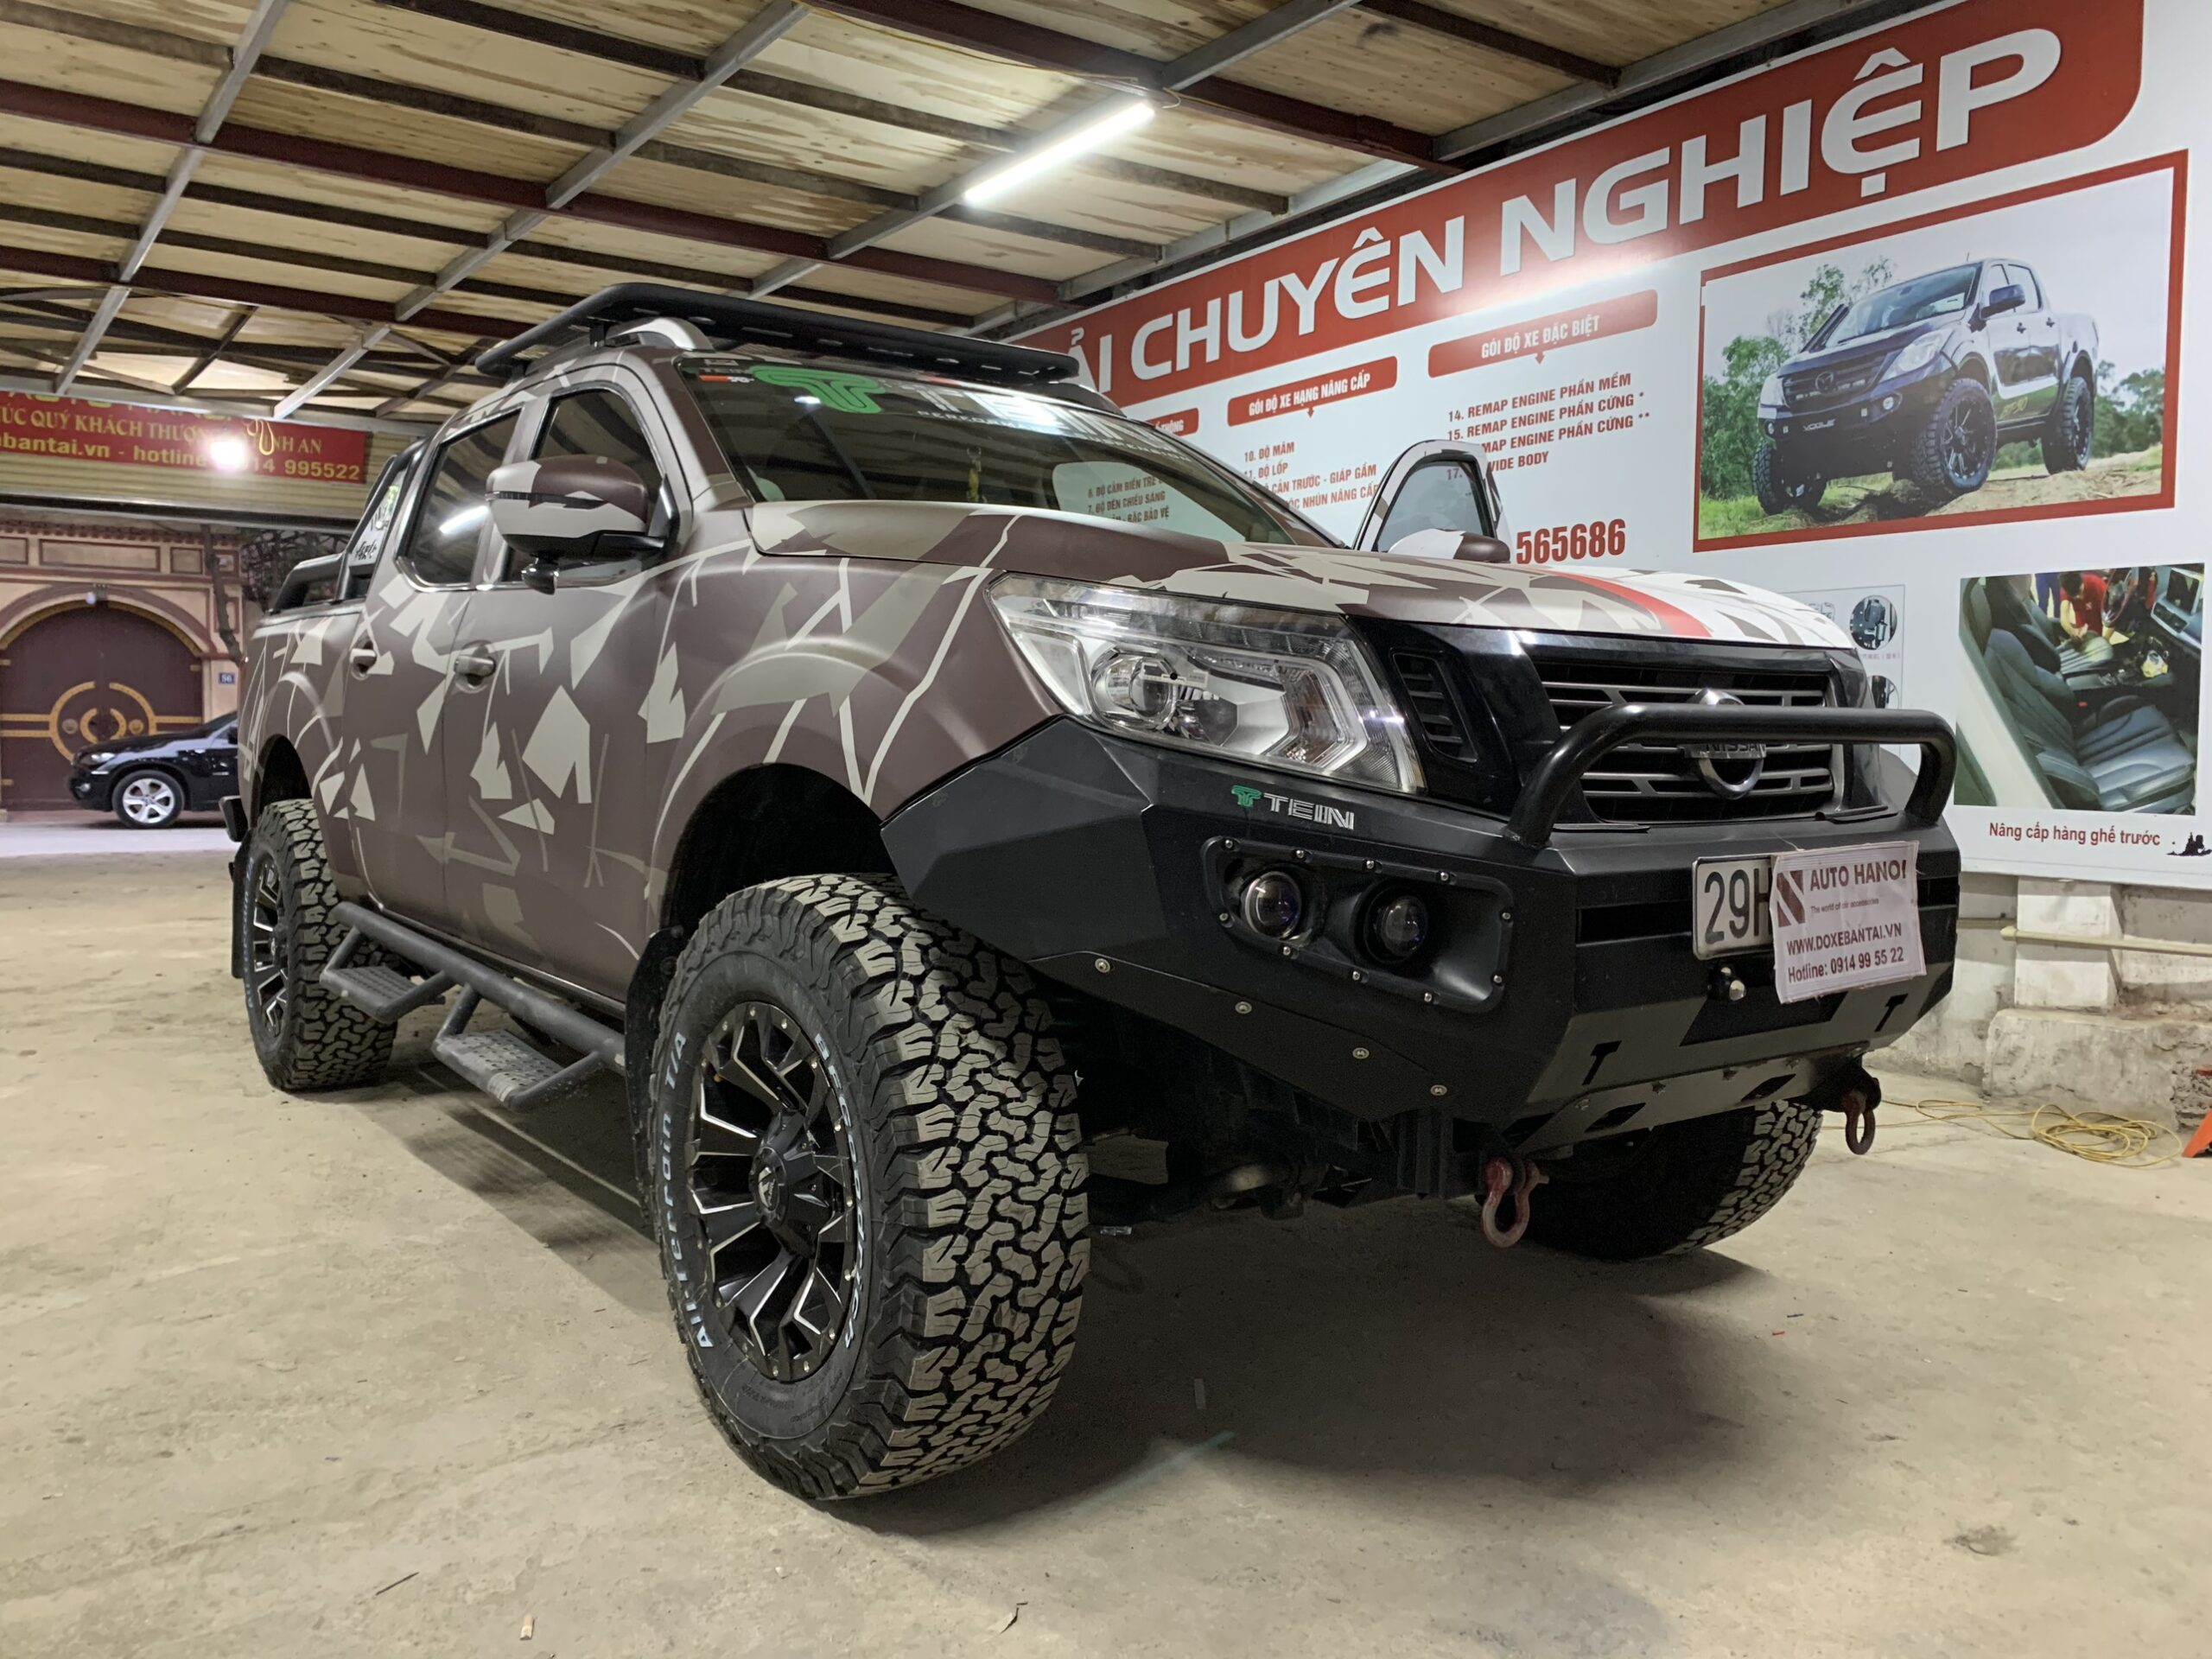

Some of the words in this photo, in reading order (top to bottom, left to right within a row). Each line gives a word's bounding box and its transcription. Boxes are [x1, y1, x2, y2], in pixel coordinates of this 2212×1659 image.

[1057, 327, 1113, 394] ẢI
[1131, 215, 1465, 380] CHUYÊN
[1500, 29, 2062, 276] NGHIỆP
[1482, 338, 1501, 359] GÓI
[1504, 333, 1521, 353] ĐỘ
[1524, 331, 1540, 348] XE
[1543, 321, 1568, 345] ĐẶC
[1572, 315, 1600, 337] BIỆT
[1249, 400, 1263, 416] GÓI
[1266, 395, 1278, 413] ĐỘ
[1280, 393, 1292, 409] XE
[1294, 387, 1319, 406] HẠNG
[1321, 378, 1348, 398] NÂNG
[1351, 369, 1370, 391] CẤP
[1448, 410, 1465, 423] 14.
[1467, 400, 1508, 418] REMAP
[1511, 389, 1555, 410] ENGINE
[0, 403, 27, 426] ÚC
[30, 410, 71, 429] QUÝ
[74, 415, 143, 438] KHÁCH
[297, 438, 322, 454] AN
[1447, 429, 1464, 442] 15.
[1466, 420, 1507, 437] REMAP
[1510, 410, 1555, 431] ENGINE
[1598, 393, 1634, 413] CỨNG
[1482, 438, 1507, 454] MAP
[1510, 431, 1554, 449] ENGINE
[1597, 415, 1633, 434] CỨNG
[0, 432, 111, 459] bantai.vn
[284, 459, 360, 480] 995522
[1244, 450, 1256, 462] 10.
[1258, 445, 1270, 461] ĐỘ
[1258, 467, 1270, 480] ĐỘ
[1272, 459, 1289, 476] LỐP
[1446, 468, 1463, 480] 17.
[1518, 451, 1549, 467] BODY
[1096, 485, 1106, 499] ĐỘ
[1330, 469, 1352, 485] GIÁP
[1145, 491, 1166, 504] SÁNG
[1302, 493, 1328, 509] NHÚN
[1331, 487, 1357, 504] NÂNG
[1516, 518, 1626, 564] 565686
[1263, 792, 1355, 830] TEIN
[1989, 822, 2022, 842] Nâng
[2025, 821, 2050, 842] cấp
[2053, 825, 2086, 845] hàng
[2090, 825, 2116, 846] ghế
[2120, 830, 2161, 846] trước
[1810, 866, 1849, 891] AUTO
[1853, 860, 1906, 885] HANOI
[1704, 867, 1771, 945] 29H
[1787, 922, 1902, 956] WWW.DOXEBANTAI.VN
[1788, 963, 1827, 983] Hotline:
[1830, 956, 1856, 975] 0914
[1859, 952, 1872, 969] 99
[1874, 949, 1888, 966] 55
[1891, 946, 1904, 963] 22
[664, 1032, 687, 1090] T/A
